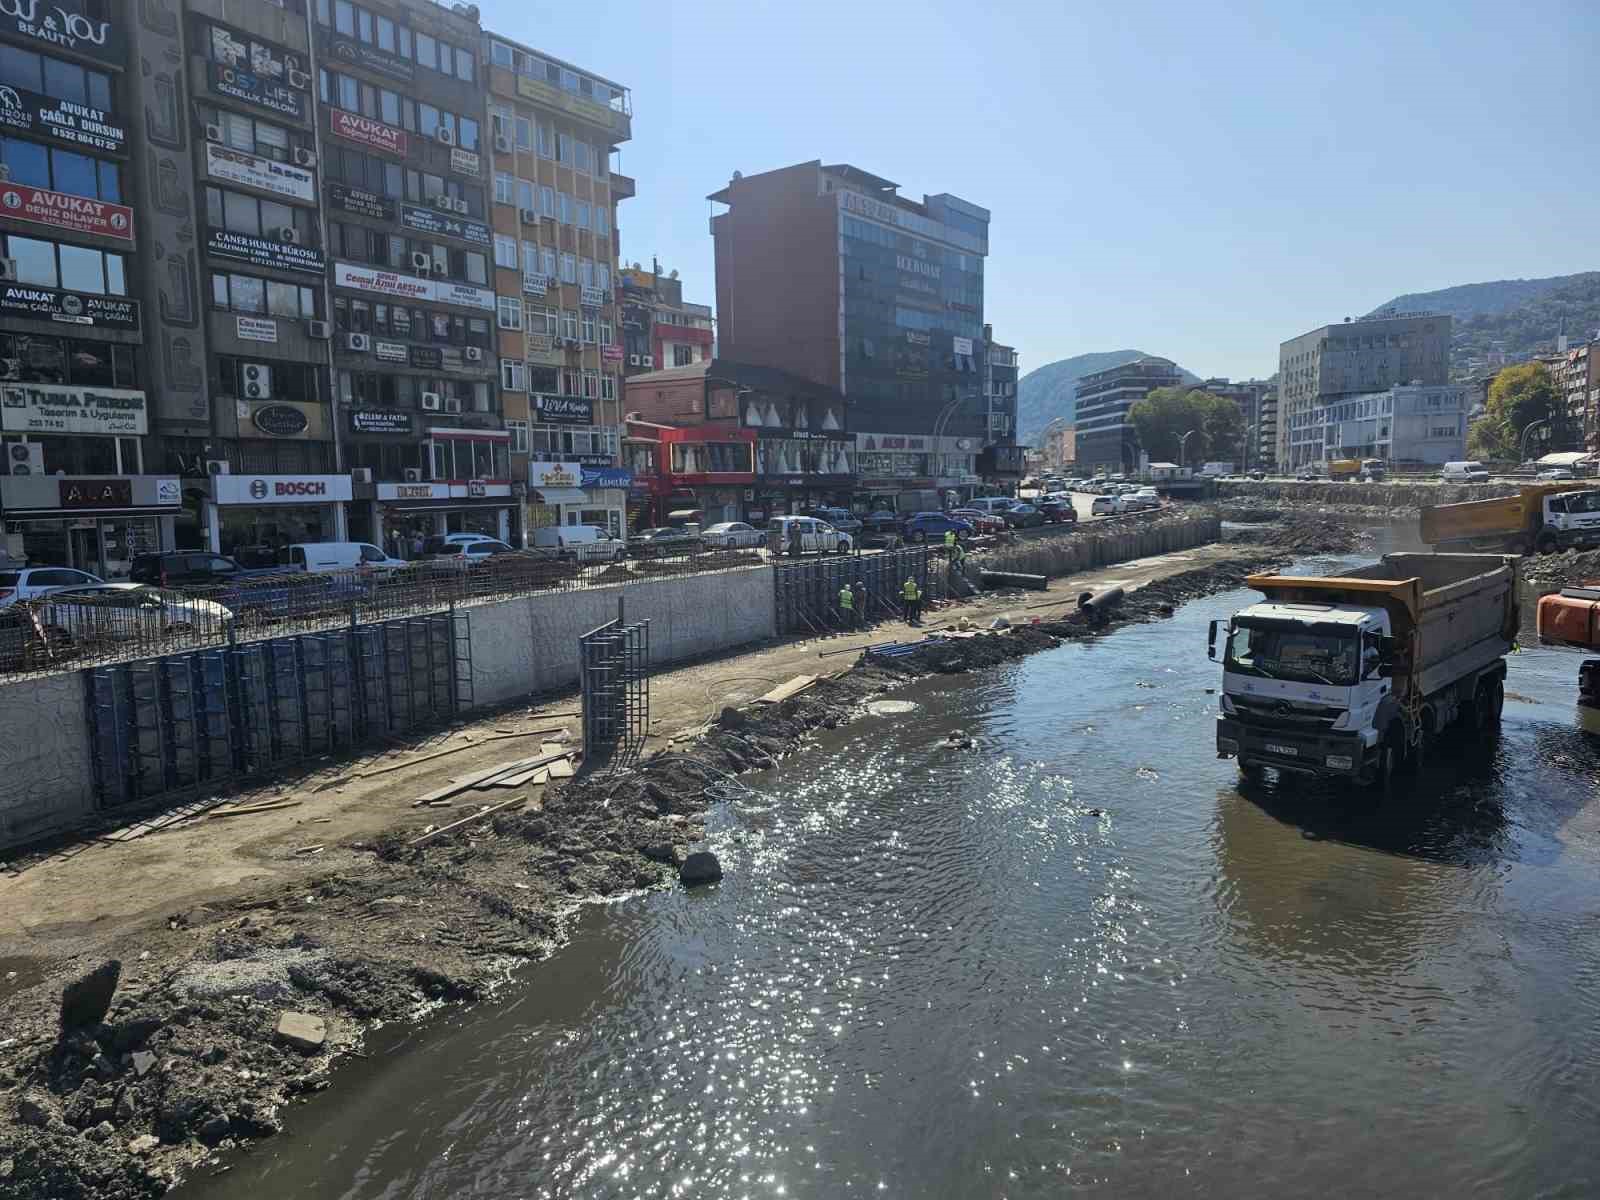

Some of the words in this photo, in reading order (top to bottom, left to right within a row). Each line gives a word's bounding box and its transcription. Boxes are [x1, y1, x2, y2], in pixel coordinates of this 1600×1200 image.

[17, 21, 77, 48] BEAUTY
[59, 101, 105, 122] AVUKAT
[39, 108, 76, 127] ÇAĞLA
[81, 120, 124, 140] DURSUN
[339, 114, 399, 141] AVUKAT
[31, 191, 105, 216] AVUKAT
[24, 203, 61, 219] DENİZ
[62, 210, 108, 228] DİLAVER
[249, 238, 281, 253] HUKUK
[281, 244, 318, 260] BÜROSU
[6, 288, 56, 304] AVUKAT
[87, 298, 132, 315] AVUKAT
[80, 409, 89, 418] &
[90, 410, 136, 421] Uygulama
[275, 482, 326, 495] BOSCH
